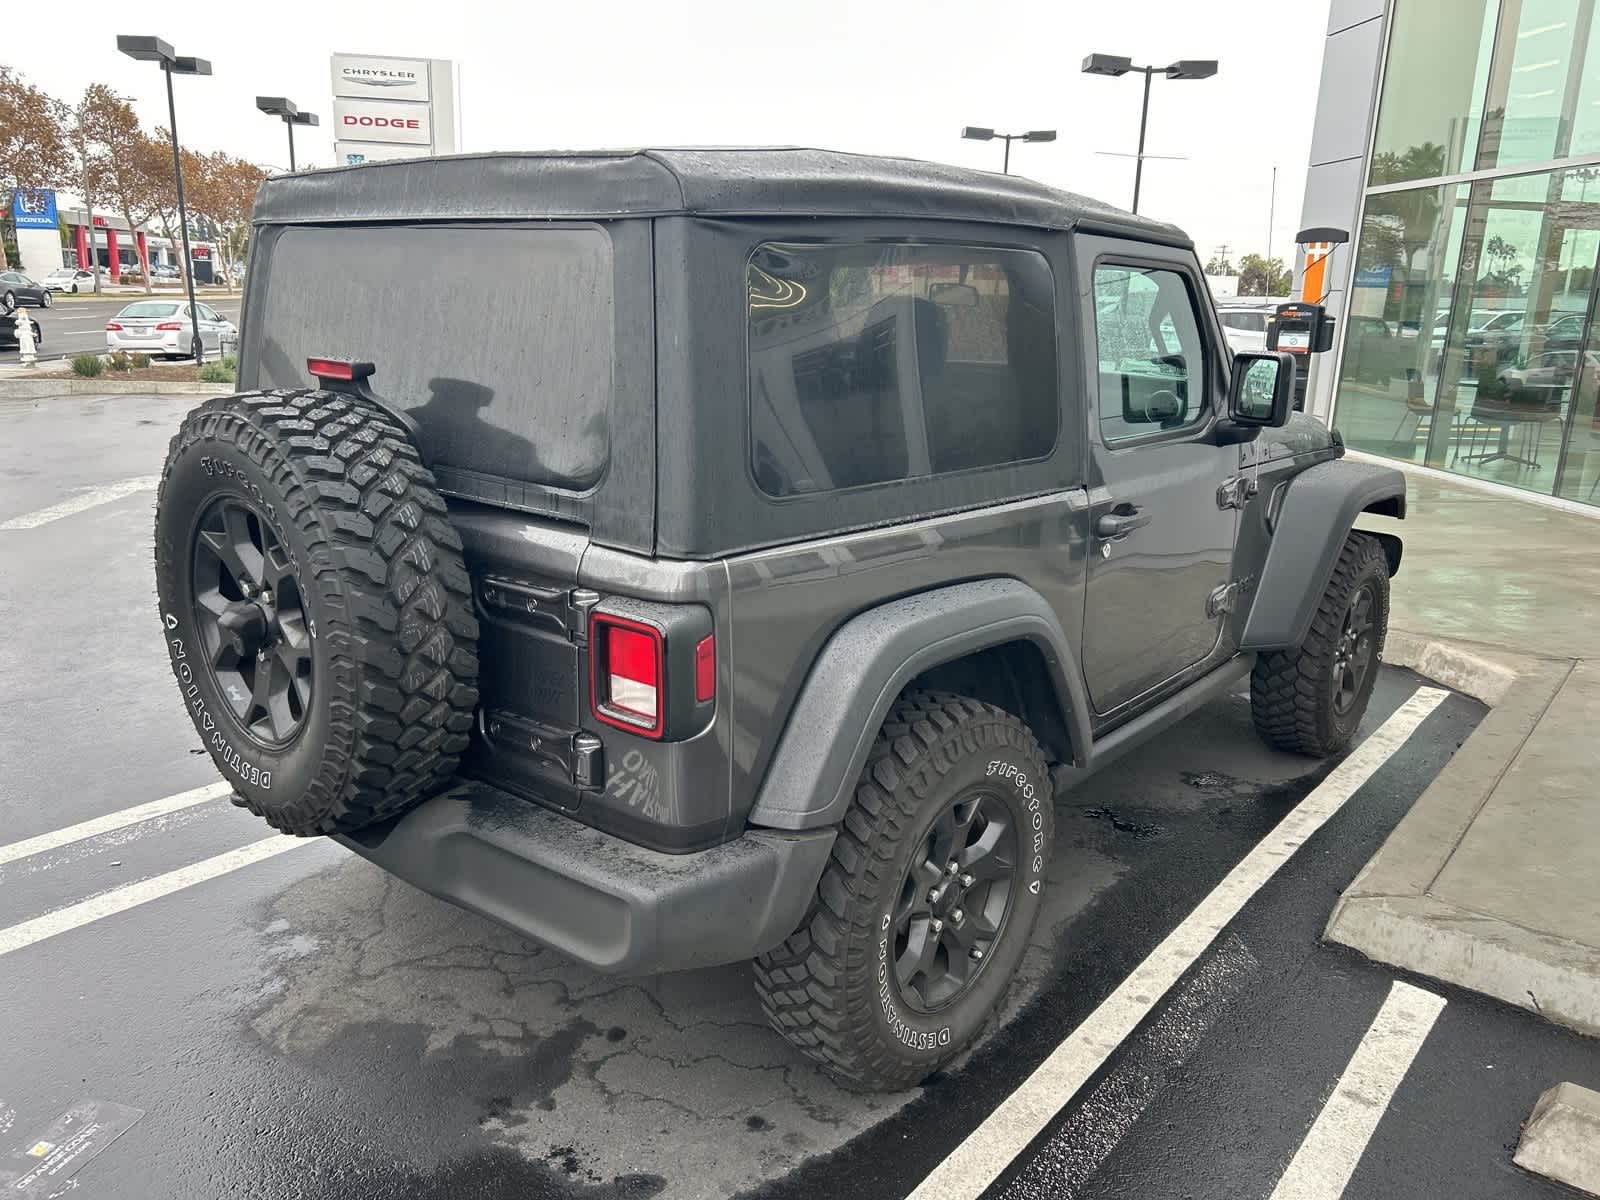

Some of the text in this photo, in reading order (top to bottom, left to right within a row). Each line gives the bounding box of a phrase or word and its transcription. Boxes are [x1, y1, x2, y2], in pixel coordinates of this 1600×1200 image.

[343, 68, 416, 79] CHRYSLER
[343, 115, 420, 129] DODGE
[171, 638, 272, 791] DESTINATION
[985, 760, 1043, 874] Firestone
[877, 938, 951, 1050] DESTINATION
